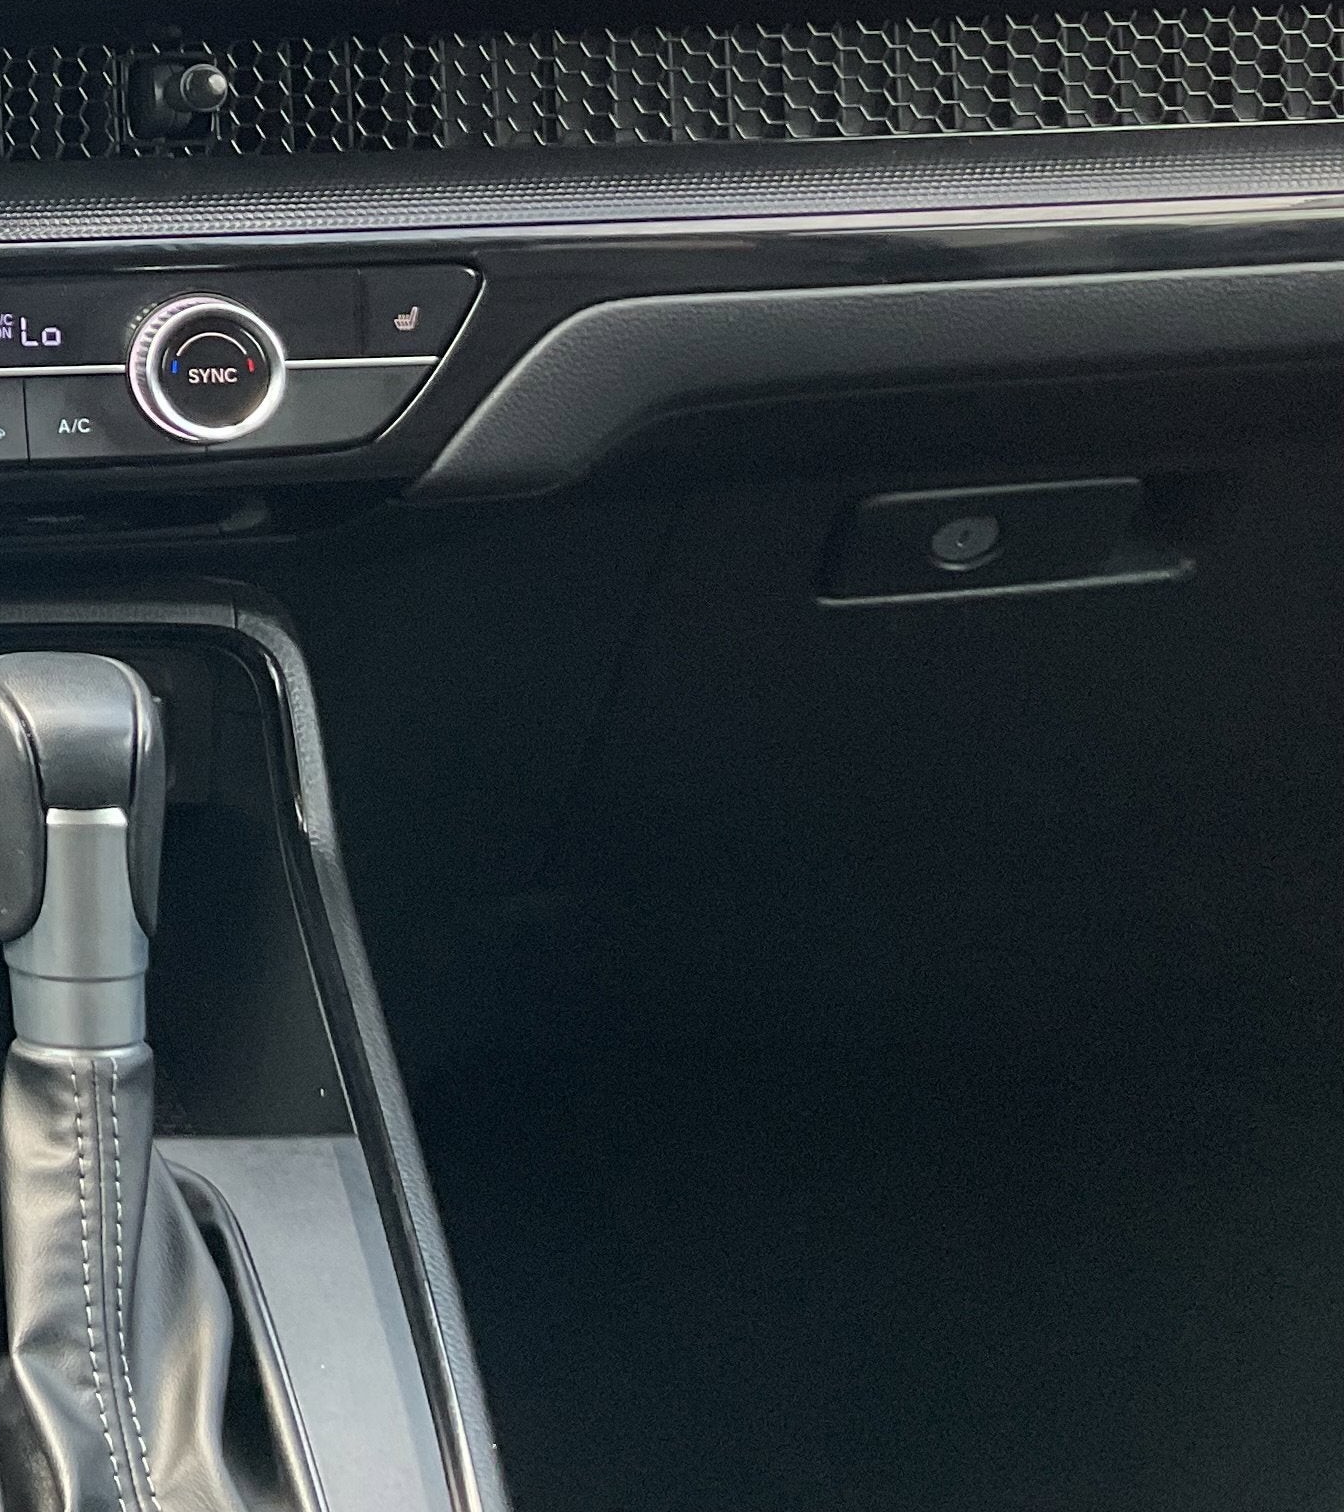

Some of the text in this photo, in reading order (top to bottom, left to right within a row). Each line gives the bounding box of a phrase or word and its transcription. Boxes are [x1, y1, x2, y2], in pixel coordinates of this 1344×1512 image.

[20, 316, 61, 347] Lo
[188, 367, 238, 384] SYNC
[58, 418, 91, 434] A/C
